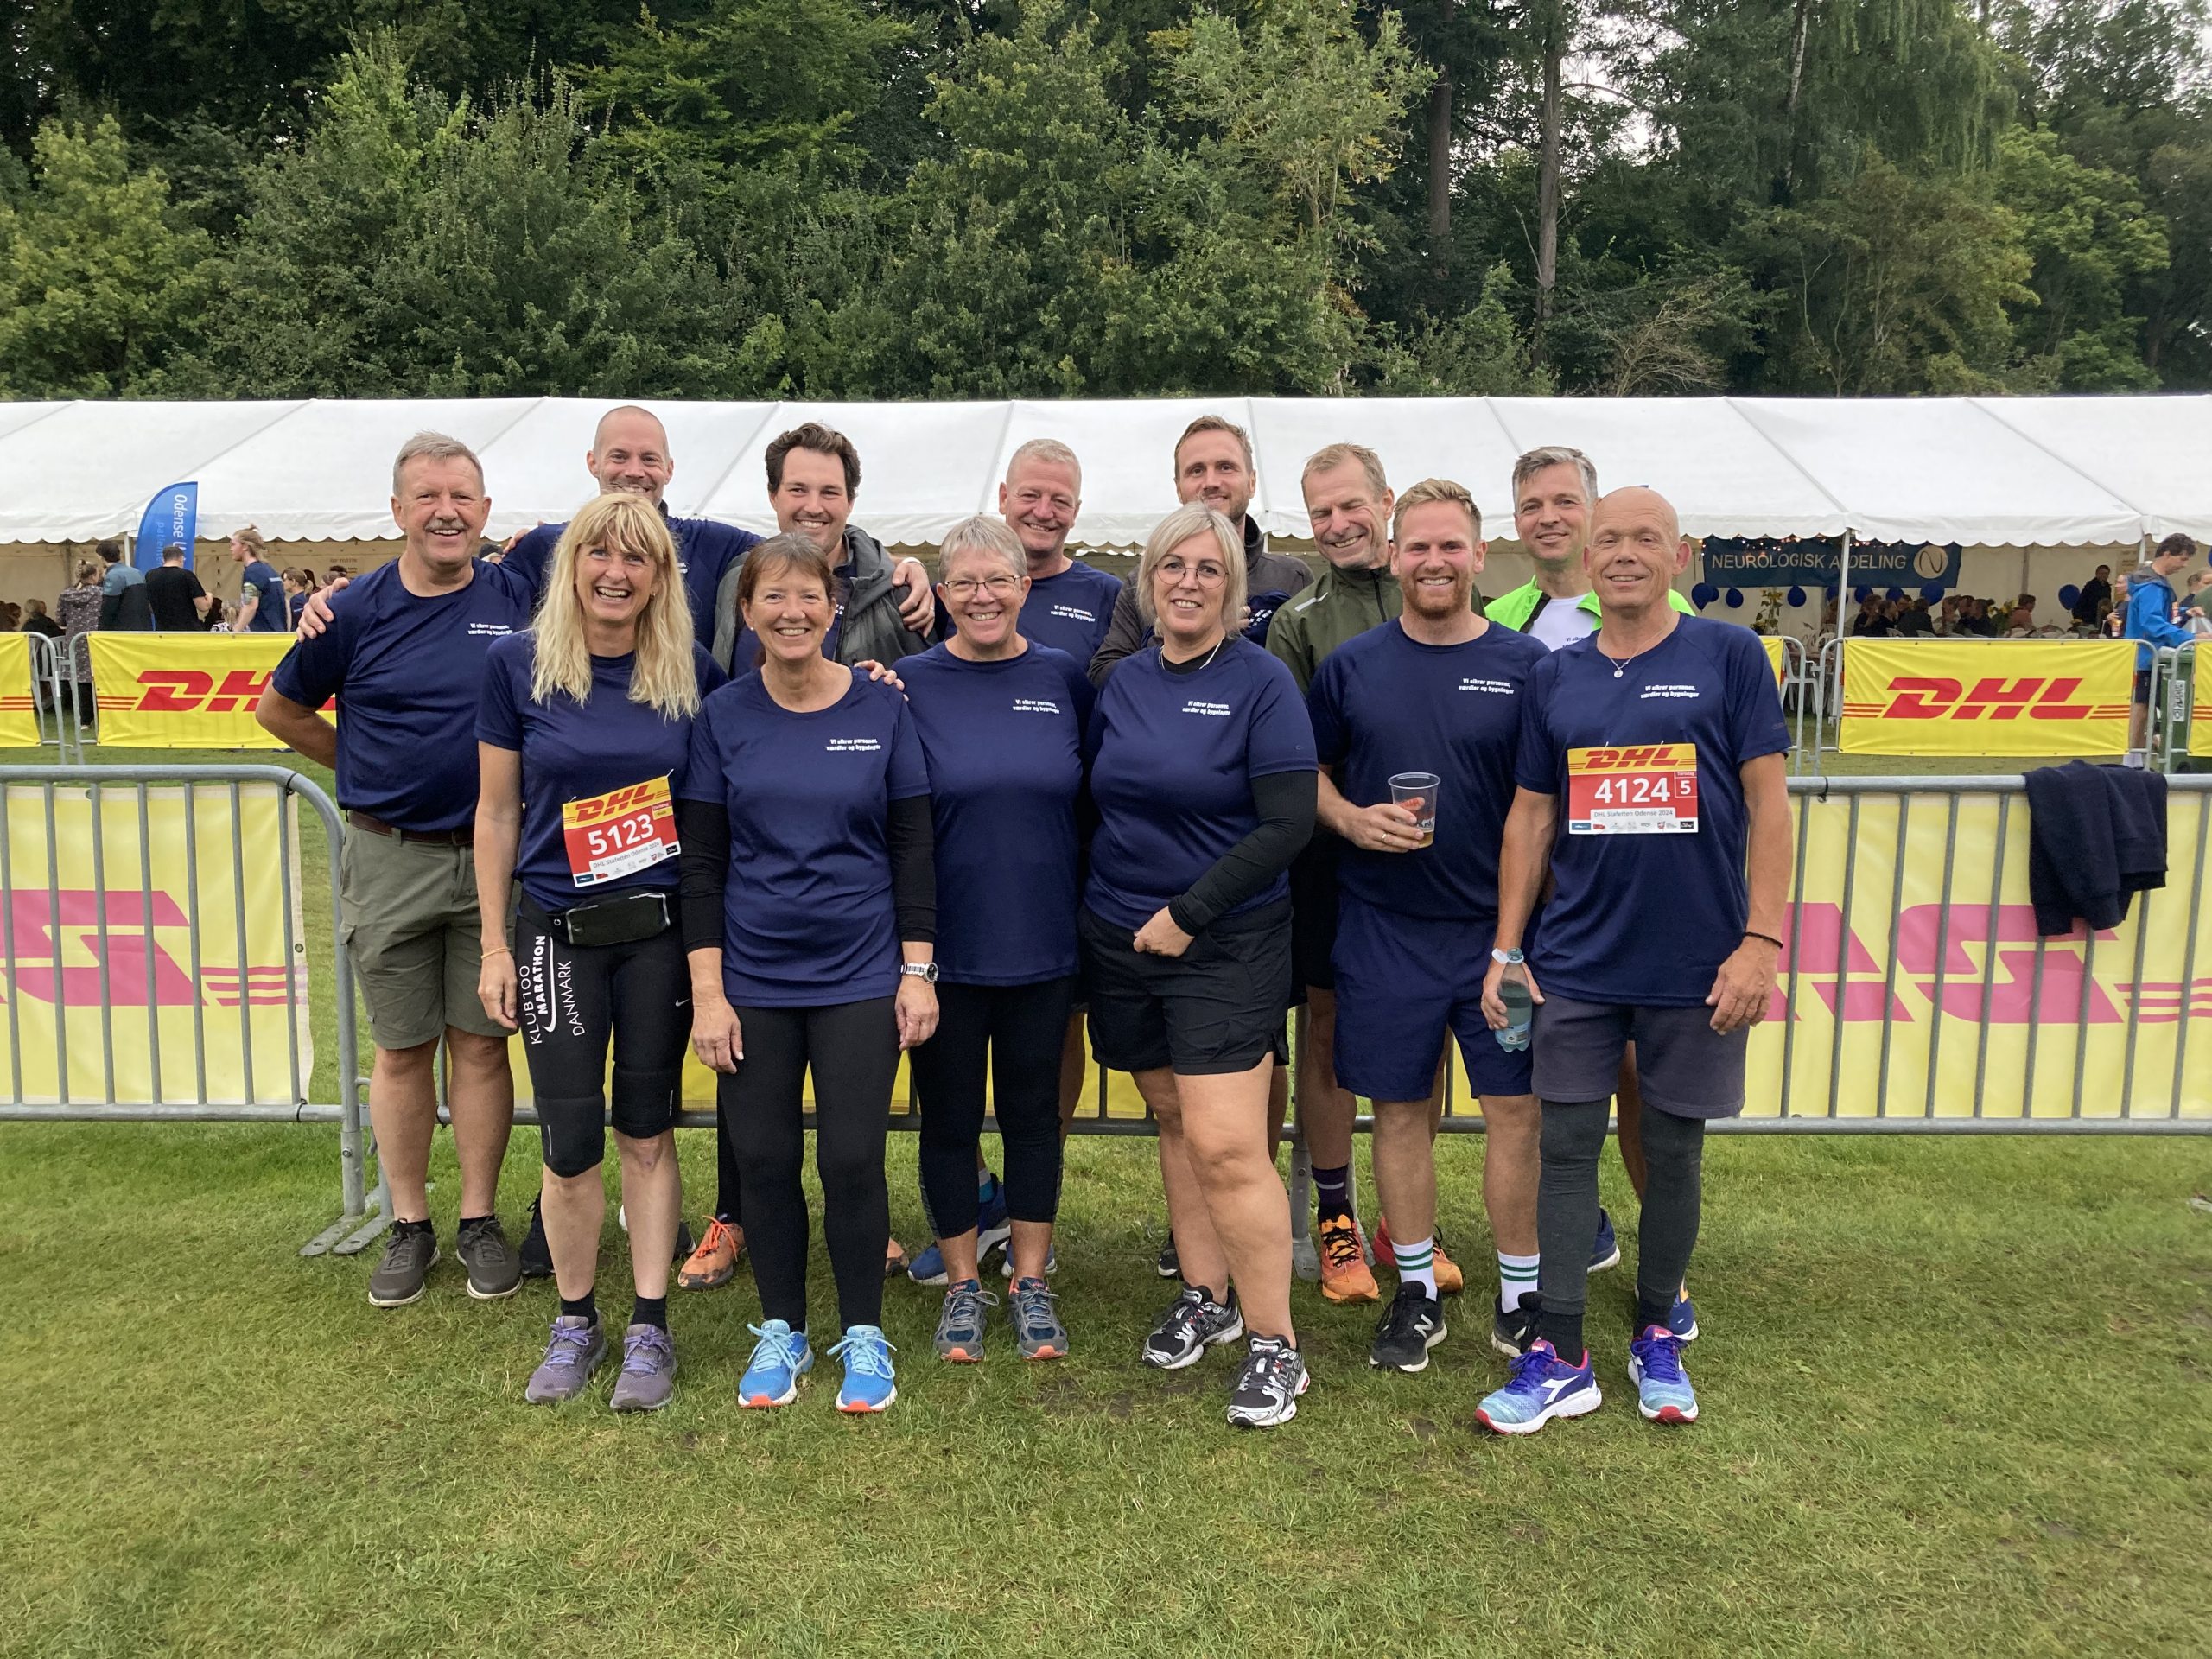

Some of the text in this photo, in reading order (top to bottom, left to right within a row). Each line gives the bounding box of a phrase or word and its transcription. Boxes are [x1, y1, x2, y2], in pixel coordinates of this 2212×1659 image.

[174, 494, 188, 538] Odense
[1712, 552, 1907, 569] NEUROLOGISK ADELING
[135, 671, 336, 712] DH
[1488, 686, 1515, 695] bygninger
[1669, 690, 1700, 699] bygninger
[1883, 677, 2094, 720] DHL
[1584, 747, 1680, 769] DHL
[575, 784, 656, 822] DHL
[1594, 777, 1671, 804] 4124
[1680, 779, 1691, 795] 5
[588, 814, 654, 855] 5123
[606, 854, 631, 865] Stafetten
[631, 847, 649, 856] Odense
[532, 935, 549, 1014] MARATHON
[557, 960, 585, 1036] DANMARK
